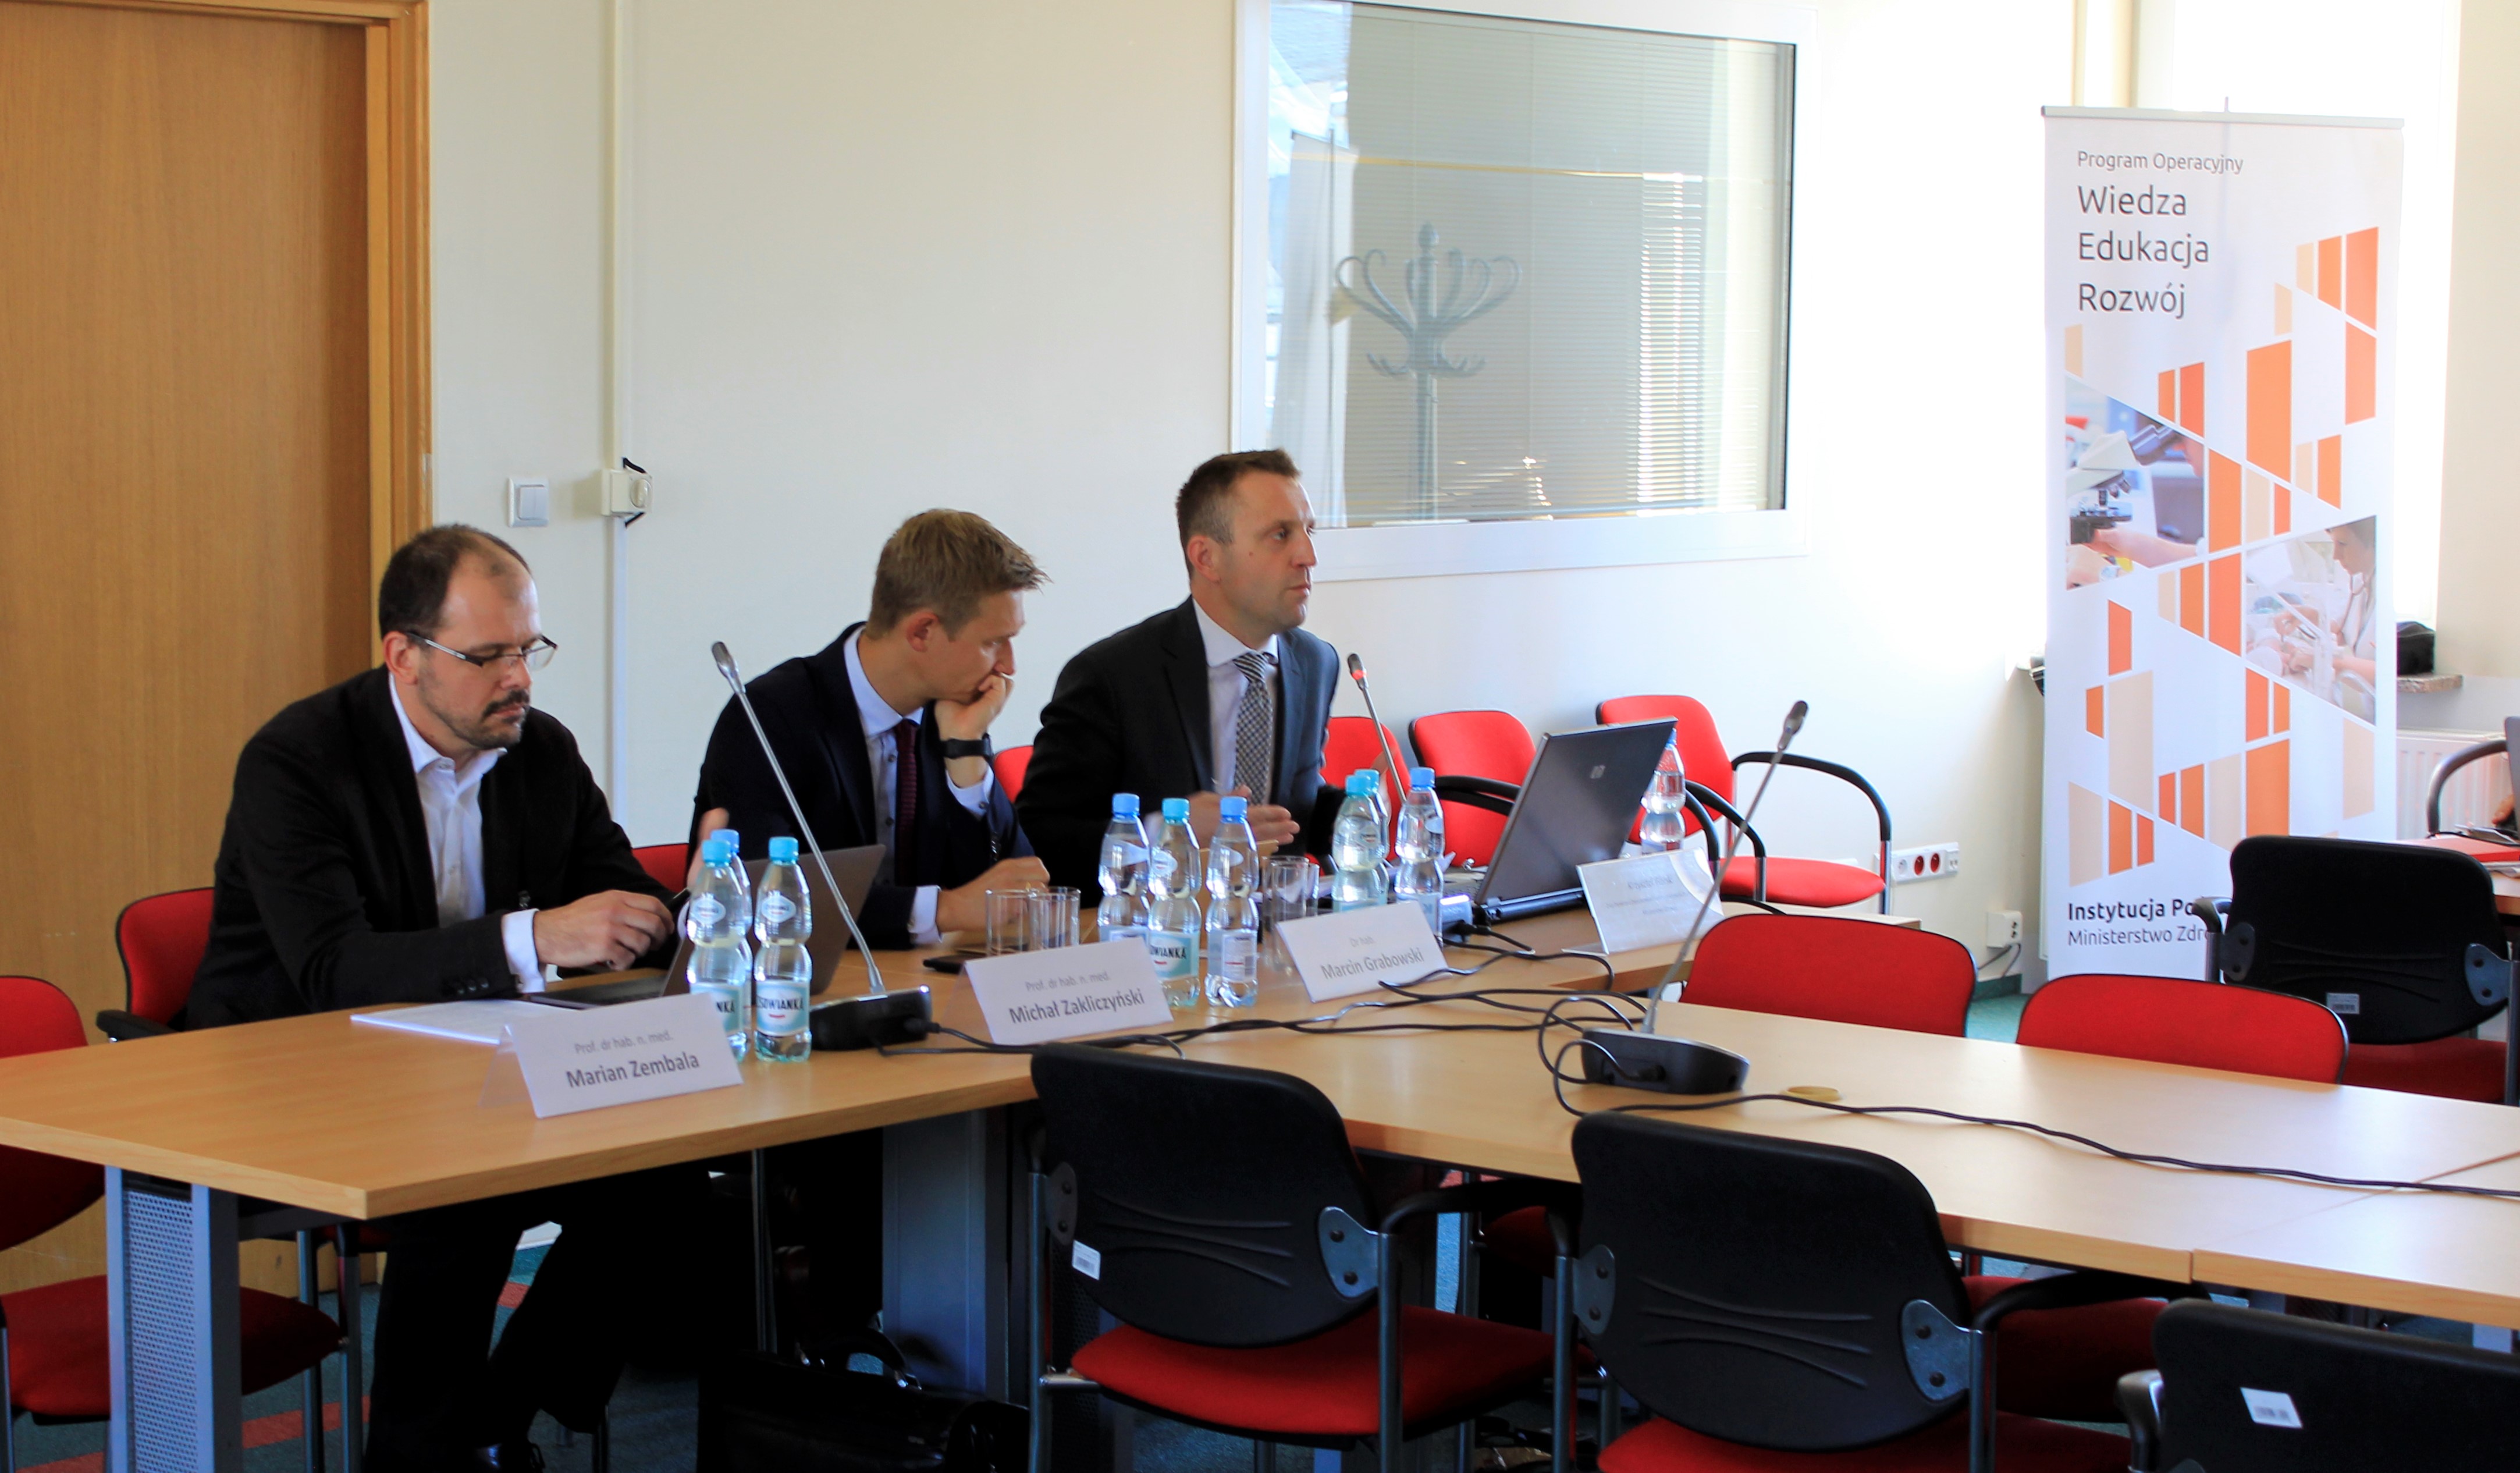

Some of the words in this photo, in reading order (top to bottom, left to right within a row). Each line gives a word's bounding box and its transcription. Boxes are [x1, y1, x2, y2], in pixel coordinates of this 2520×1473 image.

[2077, 150, 2148, 172] Program
[2152, 152, 2244, 175] Operacyjny
[2077, 184, 2187, 216] Wiedza
[2078, 229, 2209, 269] Edukacja
[2078, 282, 2185, 320] Rozwój
[2068, 898, 2166, 924] Instytucja
[2172, 899, 2194, 917] Po
[2068, 927, 2173, 946] Ministerstwo
[2177, 924, 2207, 942] Zdr
[1320, 959, 1364, 979] Marcin
[1364, 947, 1424, 971] Grabowski
[1008, 995, 1060, 1024] Michał
[1060, 988, 1145, 1016] Zakliczyński
[574, 1041, 600, 1055] Prof.
[600, 1039, 613, 1050] dr
[566, 1064, 628, 1088] Marian
[628, 1051, 700, 1079] Zembala
